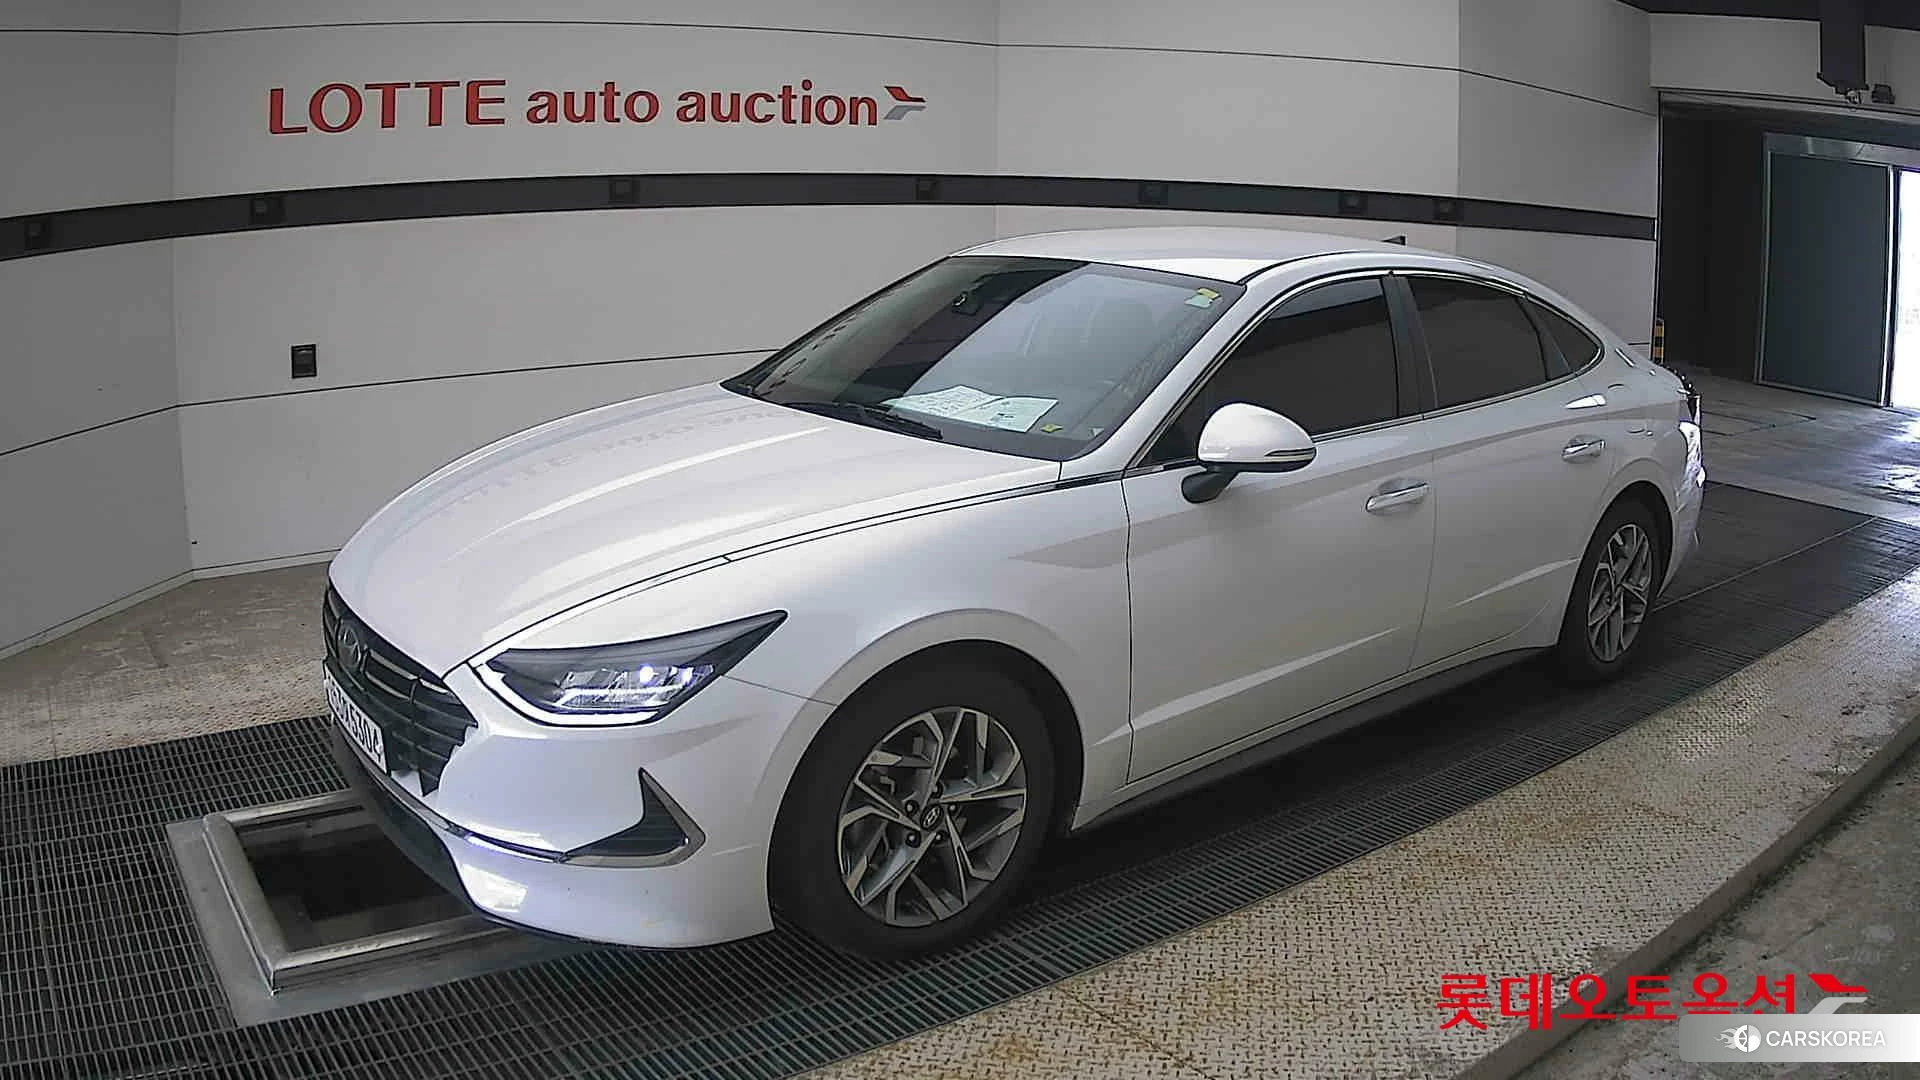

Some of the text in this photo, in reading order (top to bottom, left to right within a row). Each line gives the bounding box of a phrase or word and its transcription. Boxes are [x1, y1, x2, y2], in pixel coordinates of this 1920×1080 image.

[269, 79, 877, 134] LOTTE auto auction
